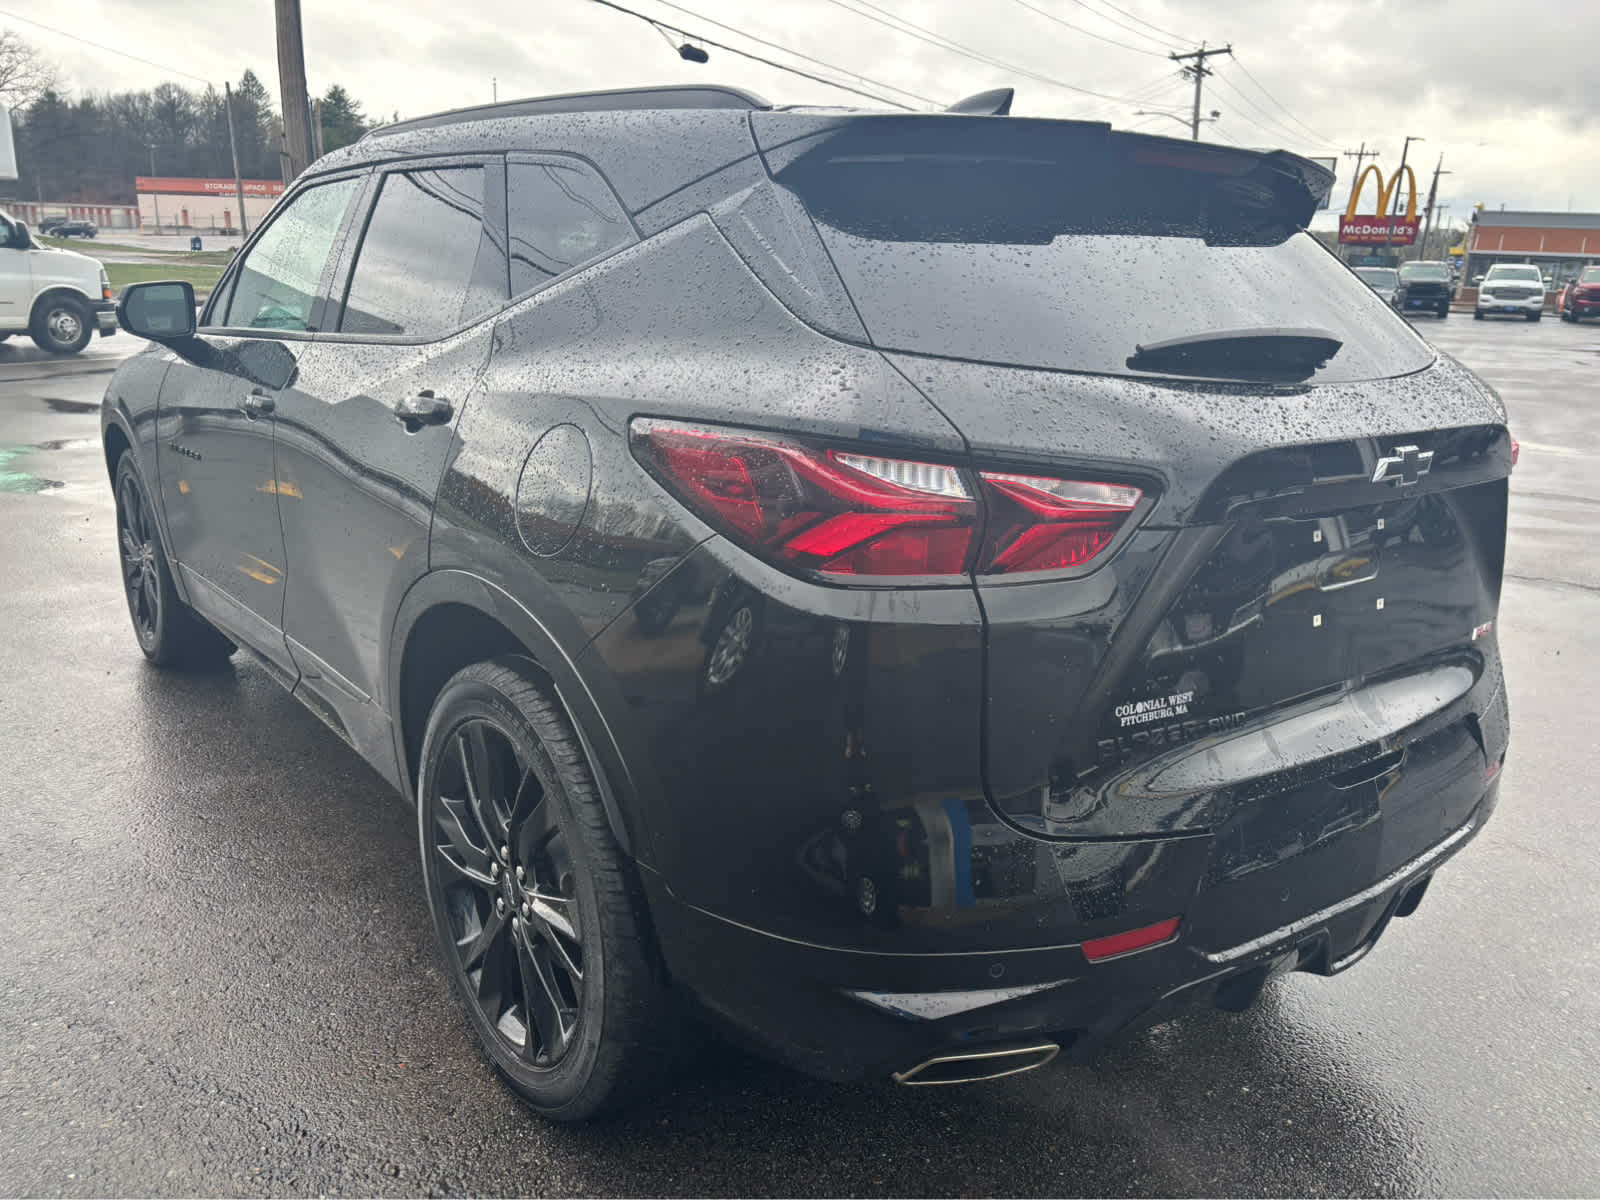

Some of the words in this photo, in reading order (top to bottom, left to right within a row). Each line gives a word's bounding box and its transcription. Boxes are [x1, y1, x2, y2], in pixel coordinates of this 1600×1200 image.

[204, 183, 237, 191] STORAGE
[1115, 698, 1167, 717] COLONIAL
[1168, 691, 1194, 704] WEST
[1120, 707, 1175, 727] FITCHBURG,
[1176, 704, 1188, 715] MA
